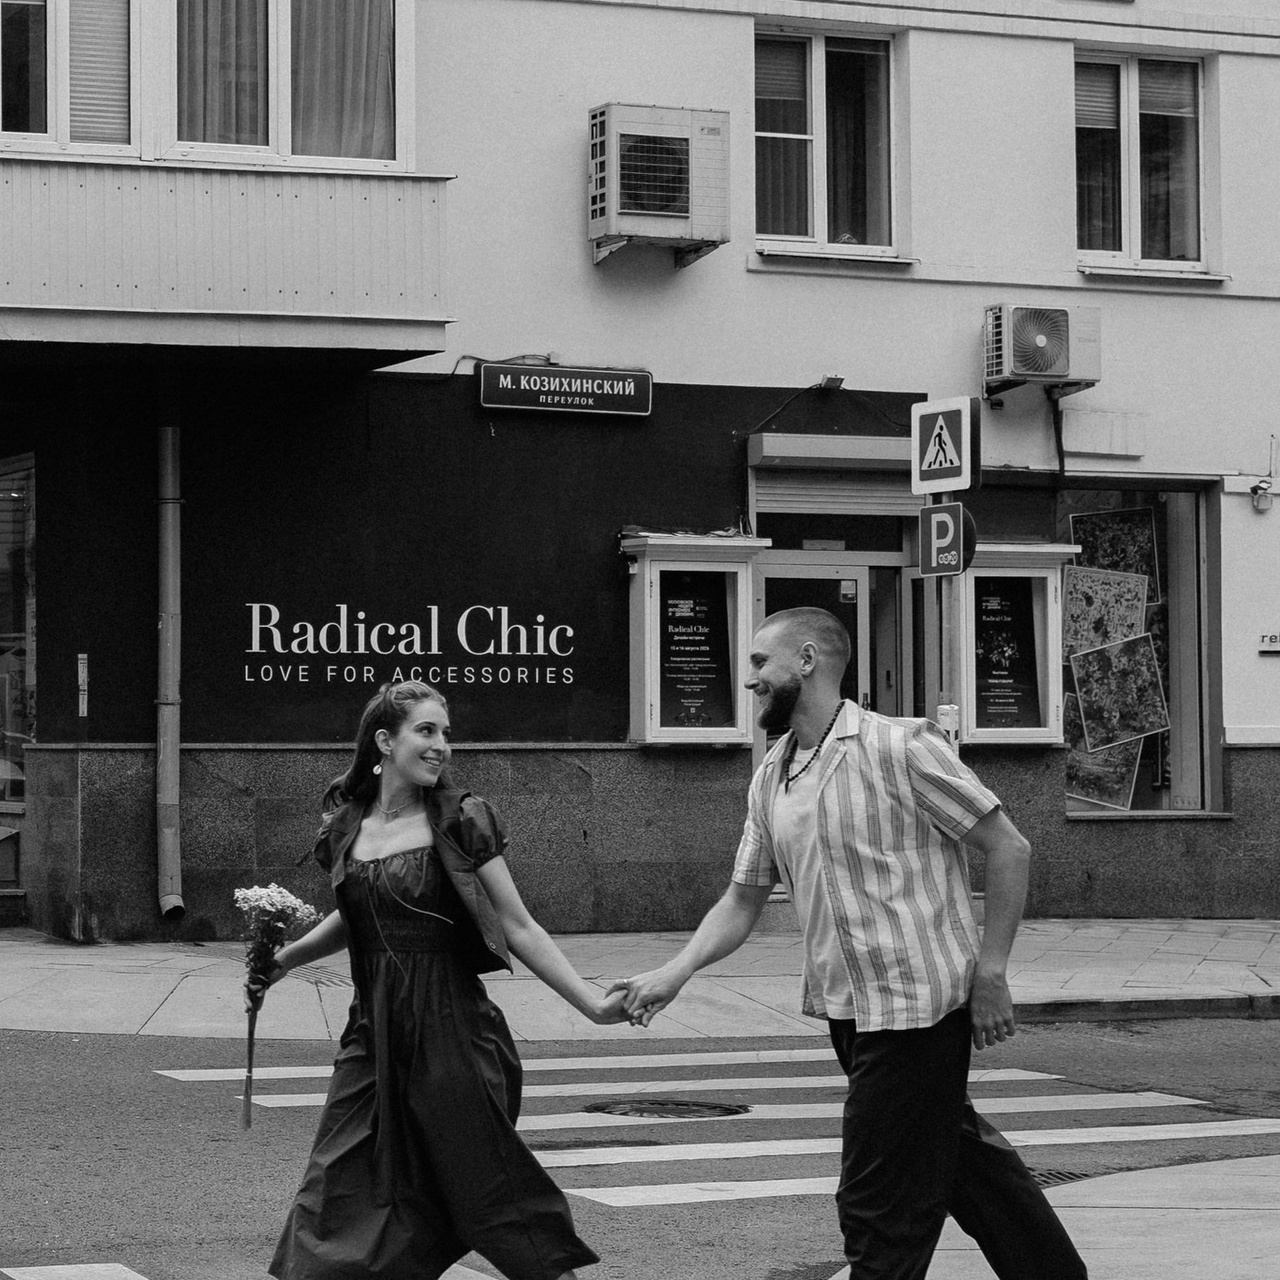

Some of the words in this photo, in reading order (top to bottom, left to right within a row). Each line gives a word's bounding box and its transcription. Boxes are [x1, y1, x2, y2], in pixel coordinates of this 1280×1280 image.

[498, 374, 516, 389] М.
[520, 375, 635, 396] КОЗИХИНСКИЙ
[539, 395, 595, 406] ПЕРЕУЛОК
[931, 513, 954, 568] P
[245, 602, 443, 656] Radical
[457, 605, 574, 657] Chic
[244, 665, 310, 682] LOVE
[327, 666, 375, 682] FOR
[391, 666, 574, 684] ACCESSORIES
